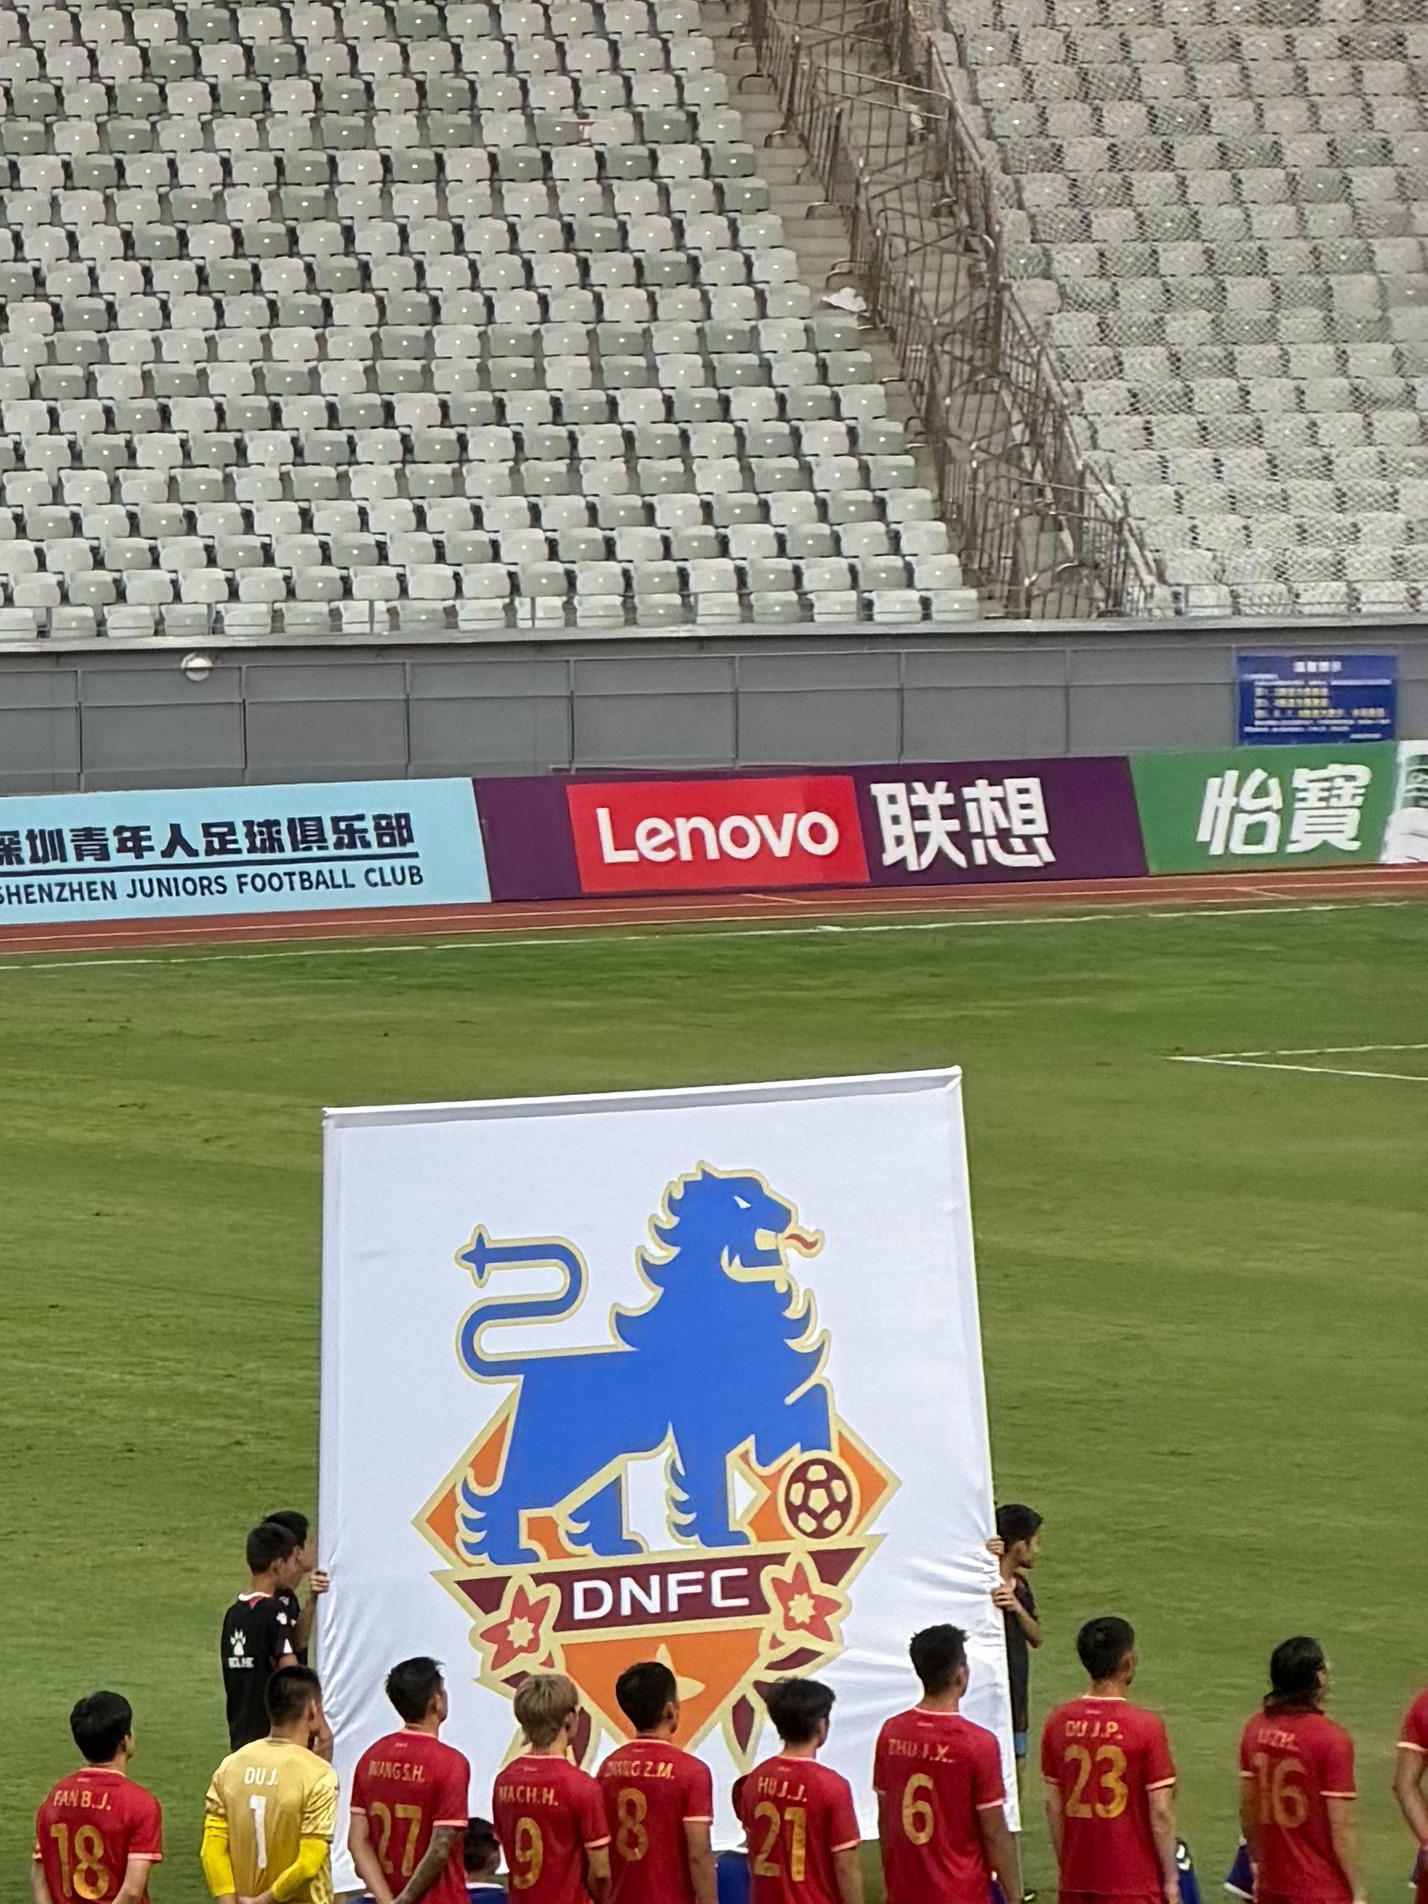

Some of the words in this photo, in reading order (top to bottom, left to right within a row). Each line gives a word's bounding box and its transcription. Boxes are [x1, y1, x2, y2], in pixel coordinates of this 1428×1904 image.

[597, 805, 840, 867] Lenovo
[869, 776, 1056, 872] 联想
[125, 873, 228, 900] JUNIORS
[237, 869, 356, 895] FOOTBALL
[362, 864, 425, 890] CLUB
[572, 1567, 750, 1621] DNFC
[53, 1789, 78, 1811] FAN
[757, 1776, 777, 1796] HU
[902, 1772, 935, 1846] 6
[1064, 1744, 1129, 1819] 23
[1251, 1752, 1308, 1829] 16
[49, 1822, 110, 1901] 18
[248, 1794, 268, 1870] 1
[369, 1801, 423, 1878] 27
[512, 1816, 543, 1890] 9
[616, 1787, 649, 1862] 8
[753, 1800, 807, 1882] 21
